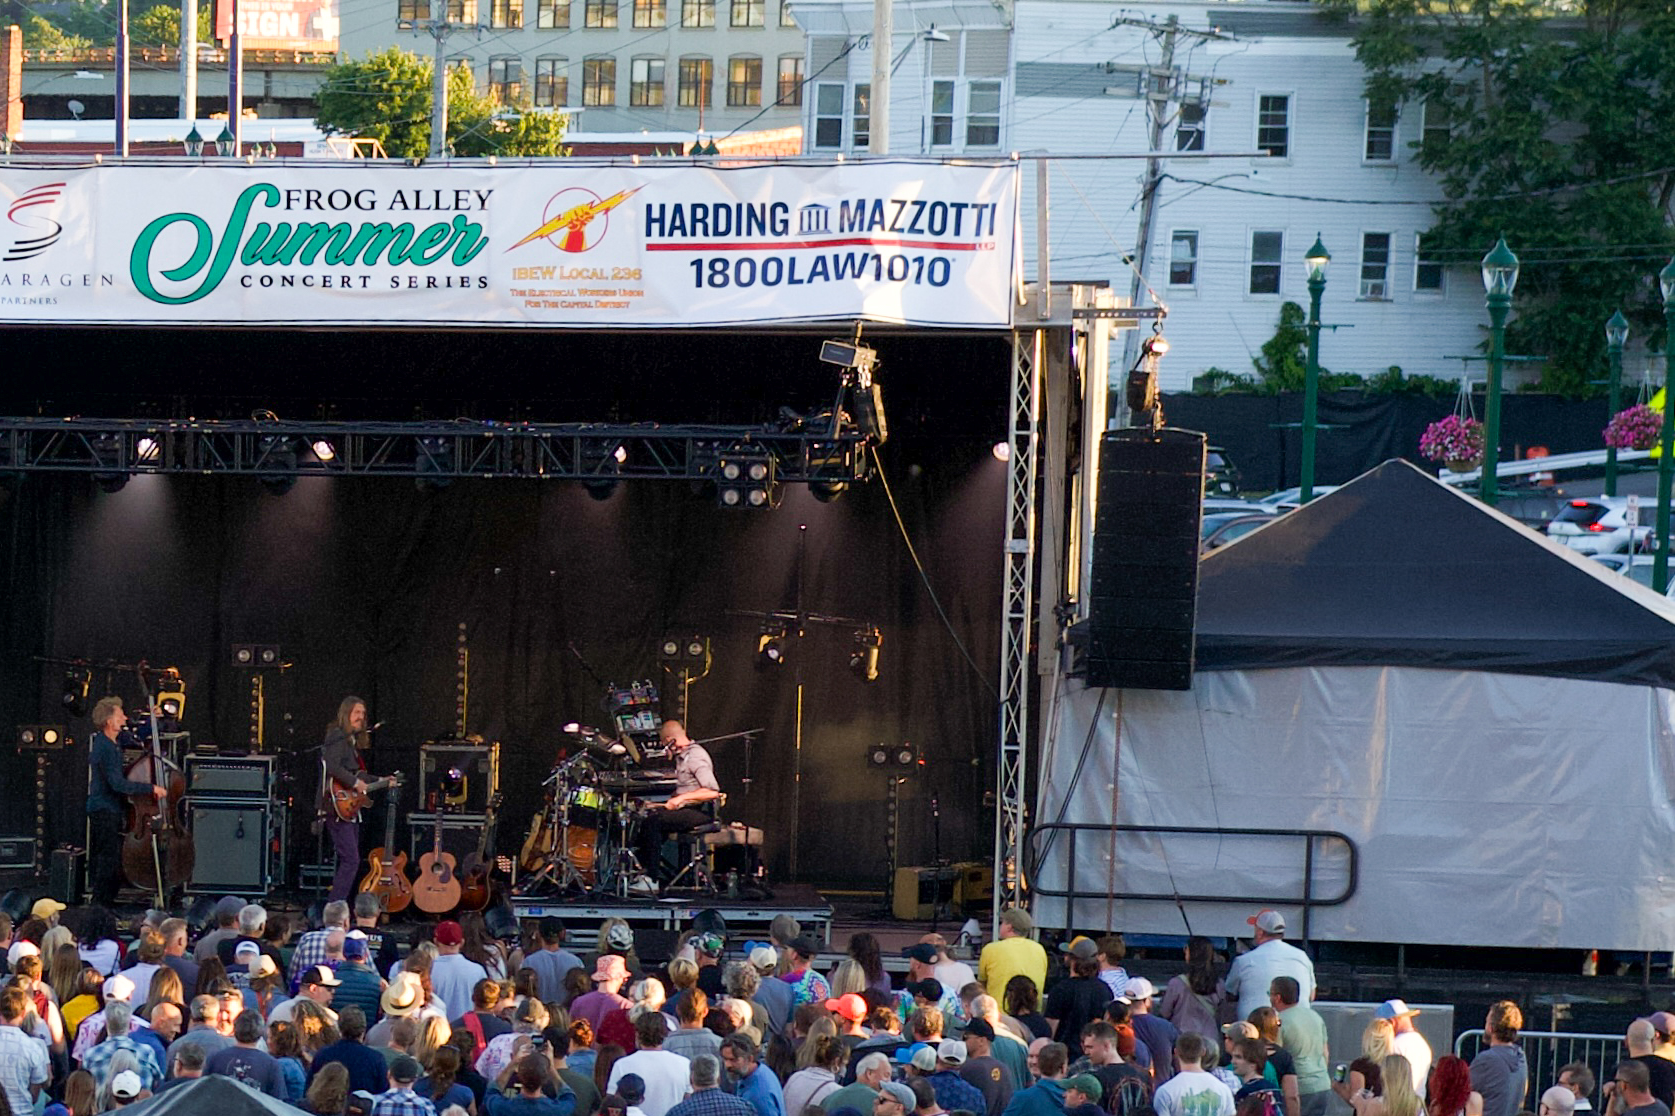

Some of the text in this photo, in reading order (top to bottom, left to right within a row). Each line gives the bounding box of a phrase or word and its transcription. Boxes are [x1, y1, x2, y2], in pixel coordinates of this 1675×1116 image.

[229, 11, 299, 37] SIGN
[284, 189, 495, 211] FROG ALLEY
[645, 198, 997, 238] HARDING MAZZOTTI
[130, 182, 490, 305] Summer
[240, 275, 489, 289] CONCERT SERIES
[512, 266, 557, 280] IBEW
[611, 266, 642, 281] 236
[1, 297, 58, 305] PARTNERS
